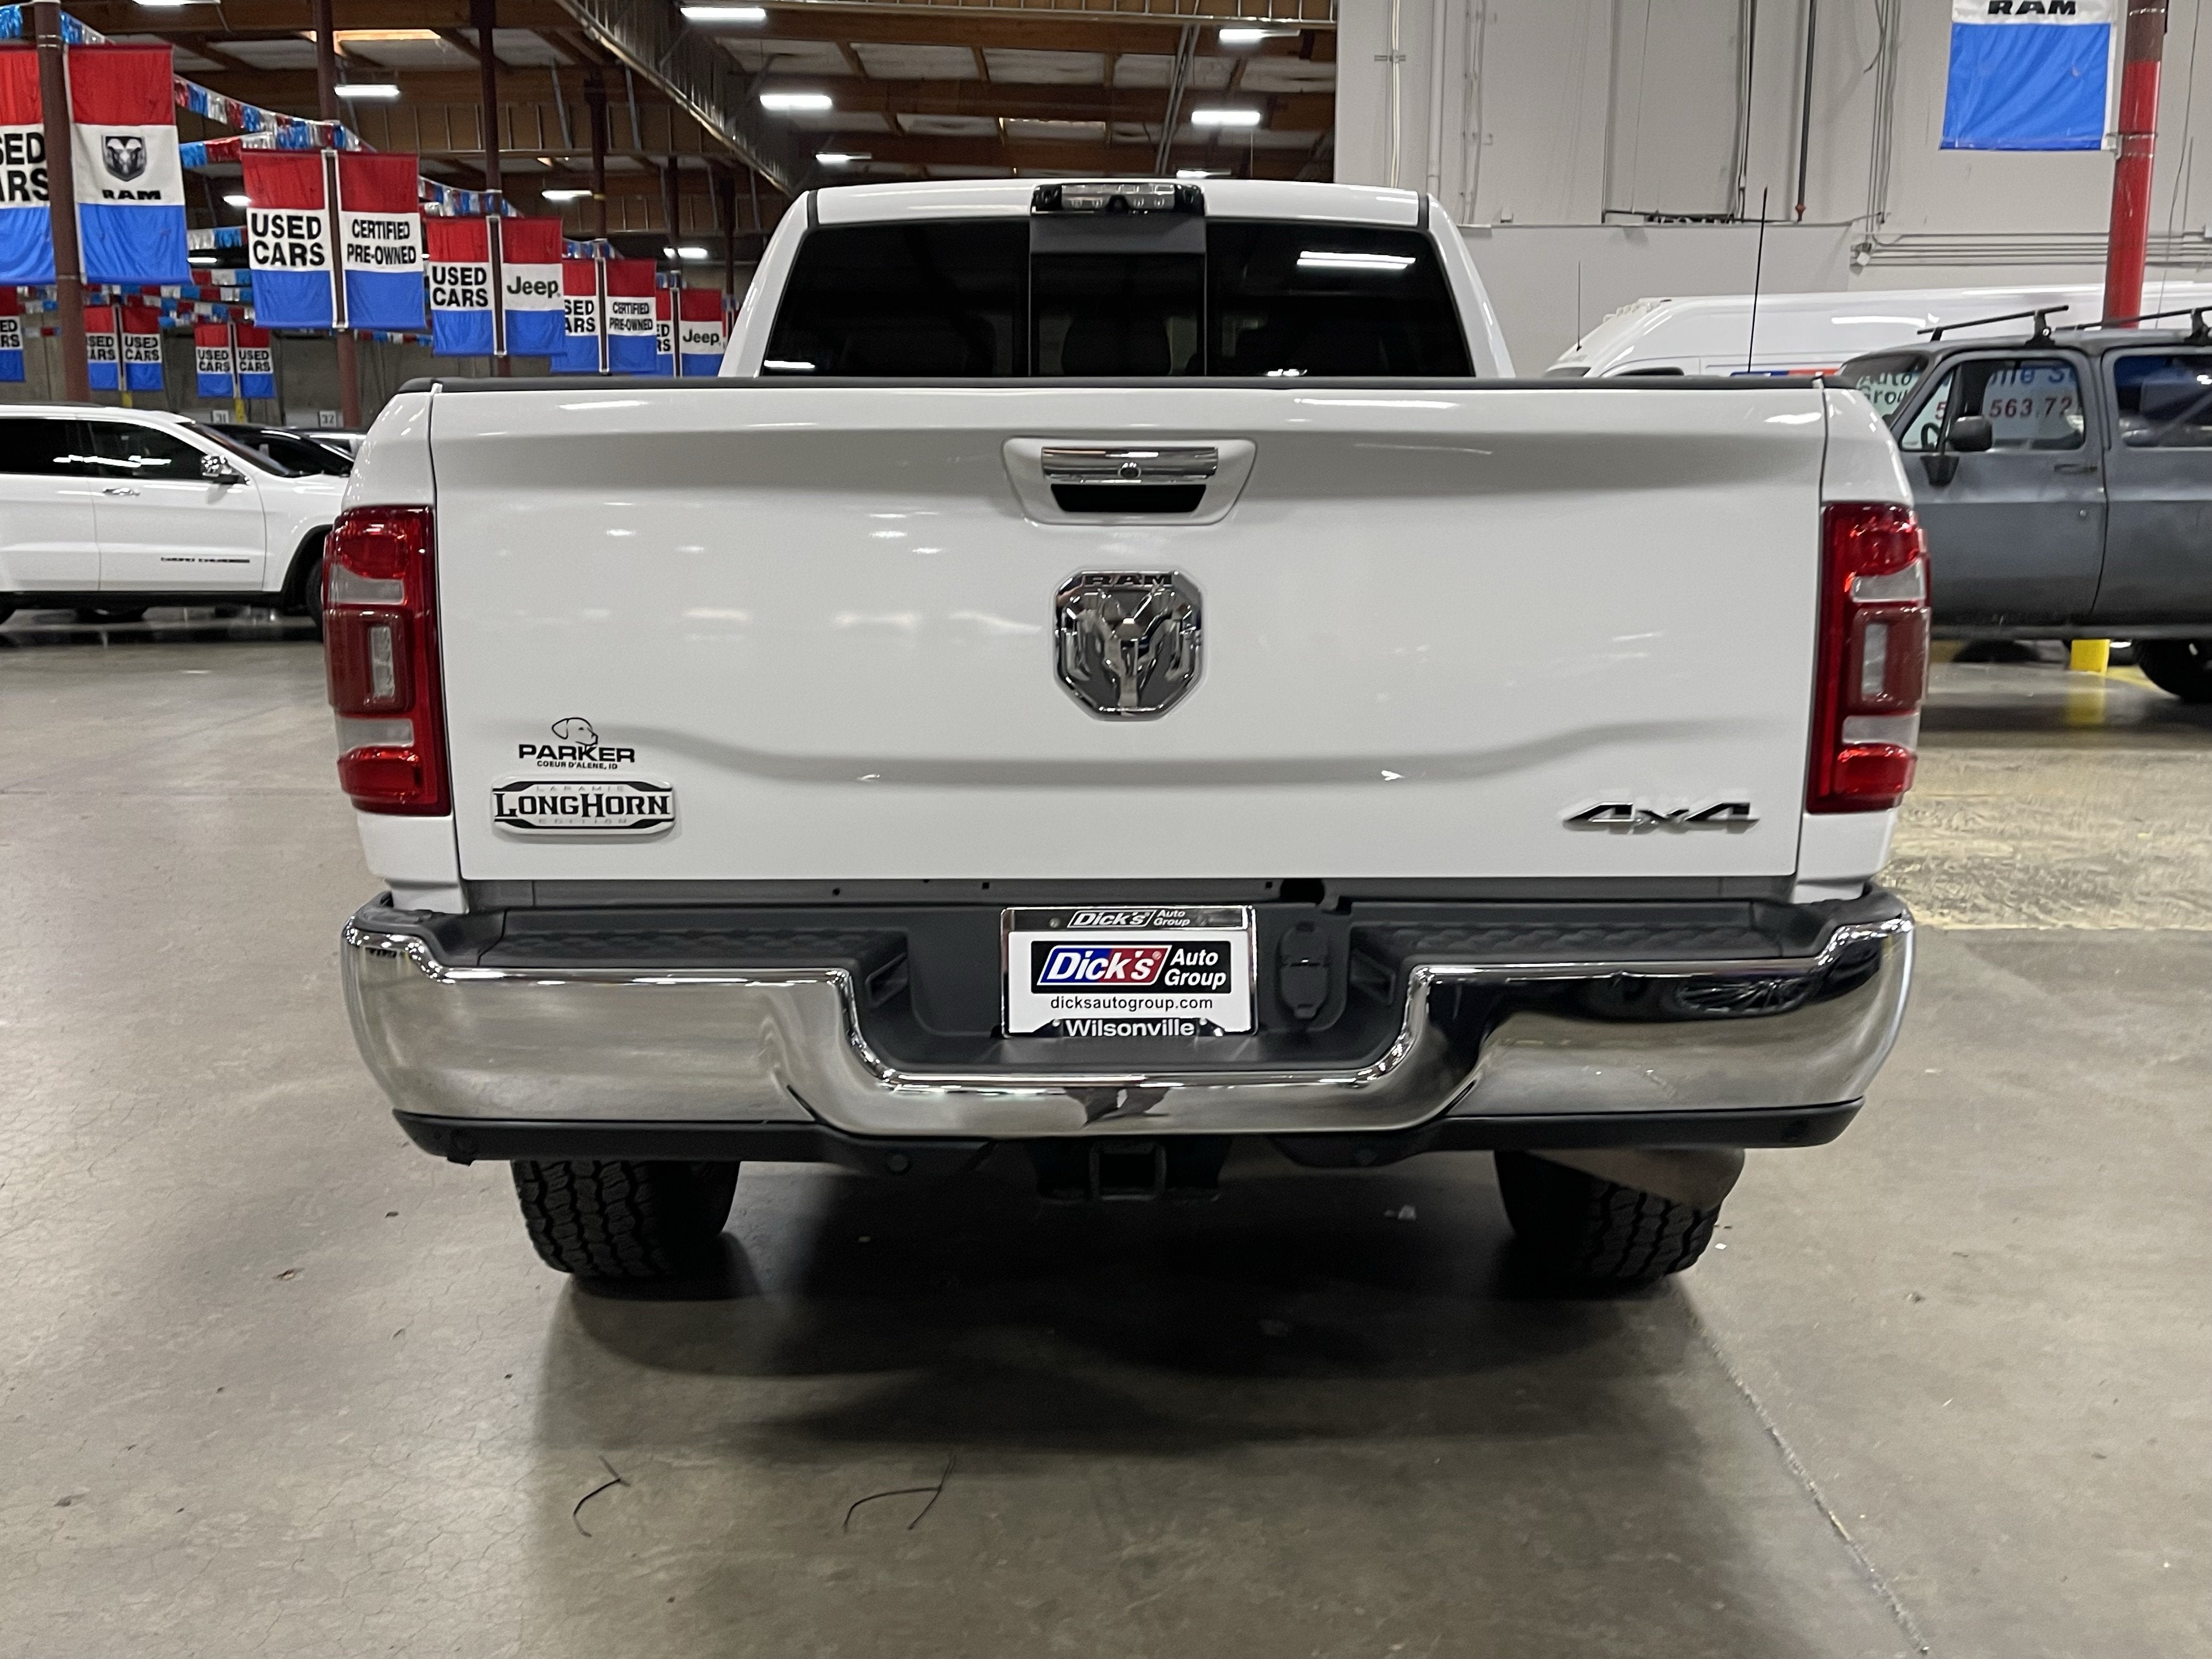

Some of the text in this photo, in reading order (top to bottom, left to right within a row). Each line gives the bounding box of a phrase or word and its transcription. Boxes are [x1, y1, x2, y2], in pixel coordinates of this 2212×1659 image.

[1988, 0, 2076, 15] RAM
[102, 190, 161, 200] RAM
[251, 213, 321, 240] USED
[352, 219, 410, 240] CERTIFIED
[253, 240, 325, 266] CARS
[347, 244, 416, 265] PRE-OWNED
[432, 266, 487, 286] USED
[506, 276, 558, 298] Jeep
[432, 287, 488, 307] CARS
[565, 299, 594, 315] SED
[613, 302, 650, 314] CERTIFIED
[565, 317, 596, 333] ARS
[609, 317, 653, 331] PRE-OWNED
[88, 336, 114, 347] SED
[125, 336, 158, 348] USED
[682, 329, 719, 346] Jeep
[91, 349, 115, 360] ARS
[125, 349, 159, 361] CARS
[198, 349, 228, 360] USED
[239, 350, 269, 360] USED
[199, 362, 230, 371] CARS
[240, 362, 270, 371] CARS
[519, 743, 635, 763] PARKER
[1157, 909, 1186, 918] Auto
[1153, 918, 1190, 927] Group
[1047, 950, 1154, 980] Dick's
[1170, 948, 1218, 966] Auto
[1164, 969, 1227, 990] Group
[1051, 995, 1213, 1012] dicksautogroup.com
[1065, 1019, 1195, 1037] Wilsonville
